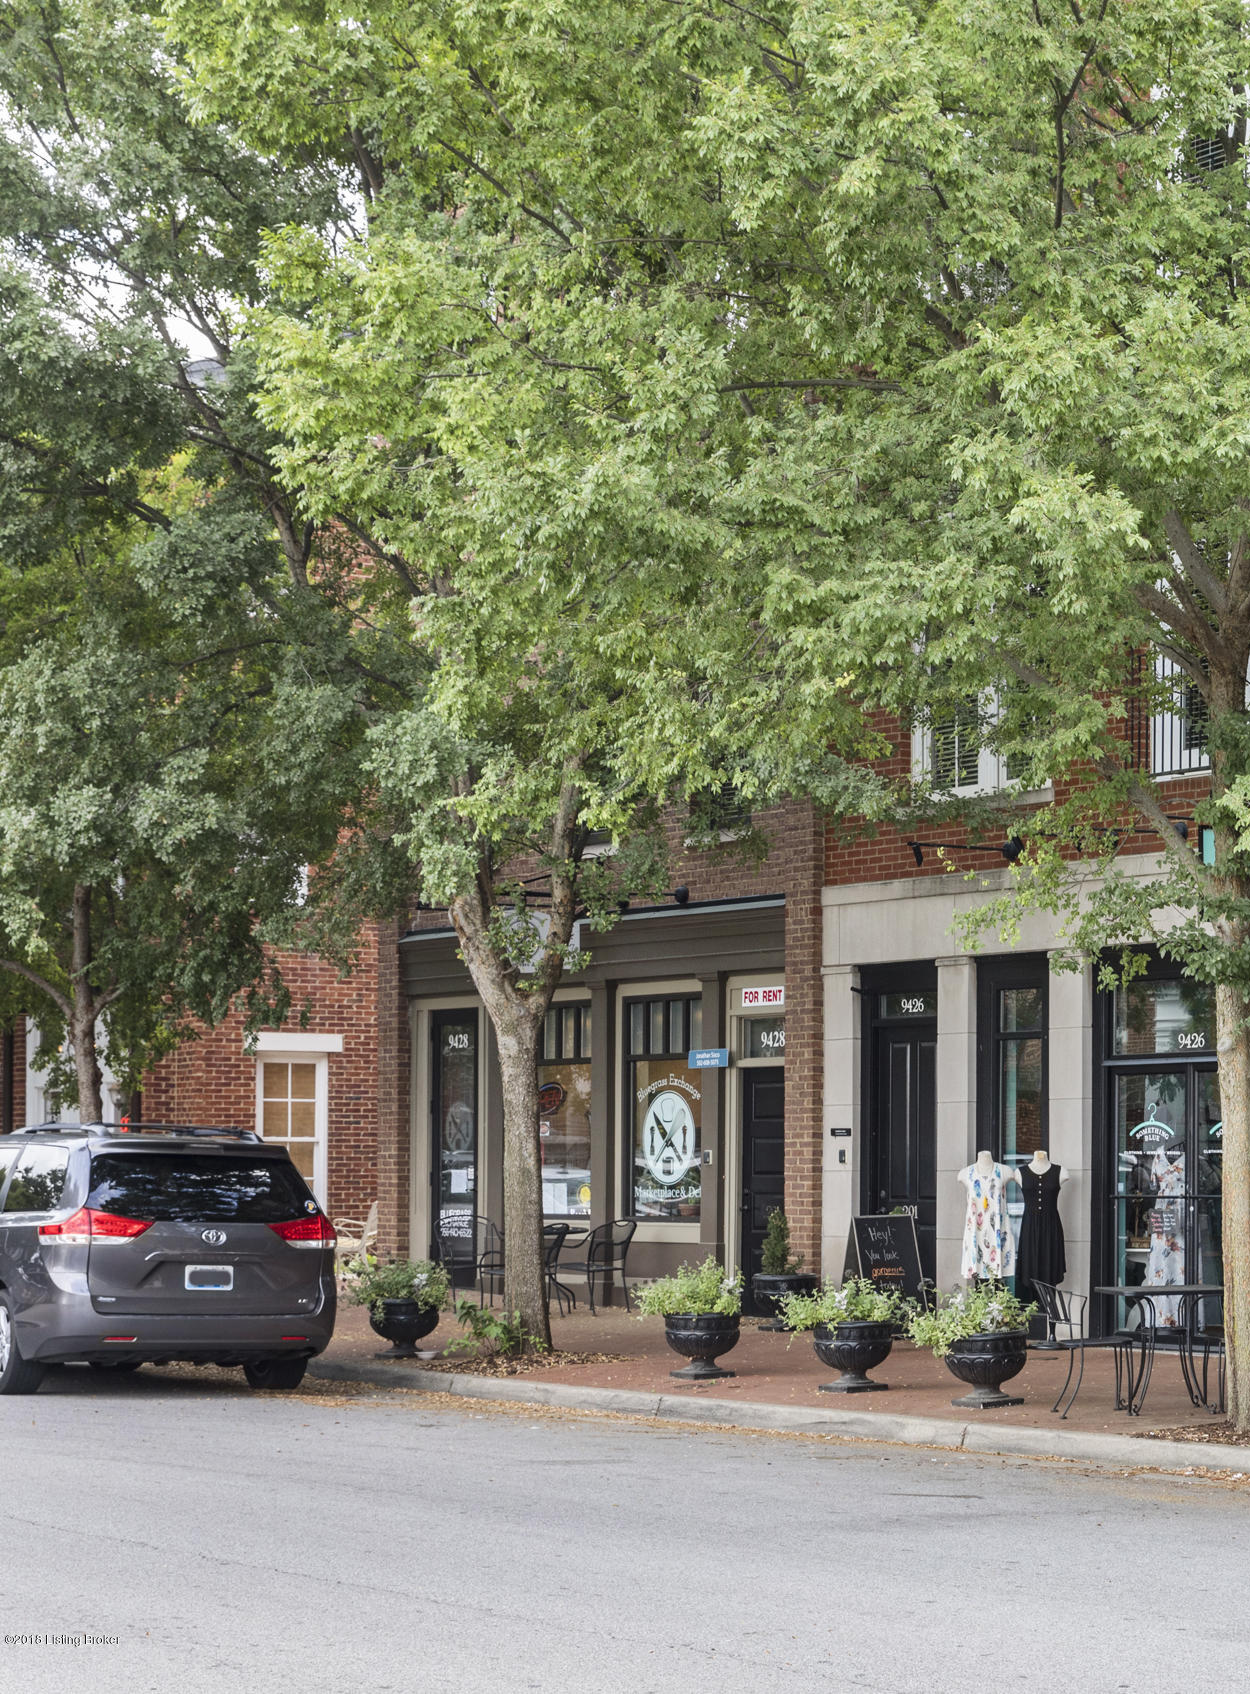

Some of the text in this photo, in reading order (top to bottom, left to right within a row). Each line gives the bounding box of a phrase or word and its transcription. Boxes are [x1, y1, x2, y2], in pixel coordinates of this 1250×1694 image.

[743, 989, 783, 1004] FOR RENT
[901, 998, 924, 1013] 9426
[448, 1033, 469, 1049] 9428
[760, 1030, 786, 1048] 9428
[1177, 1032, 1205, 1049] 9426
[636, 1073, 701, 1103] Bluegrass Exchange
[1135, 1127, 1169, 1140] SOMETHING
[1144, 1134, 1160, 1142] BLUE
